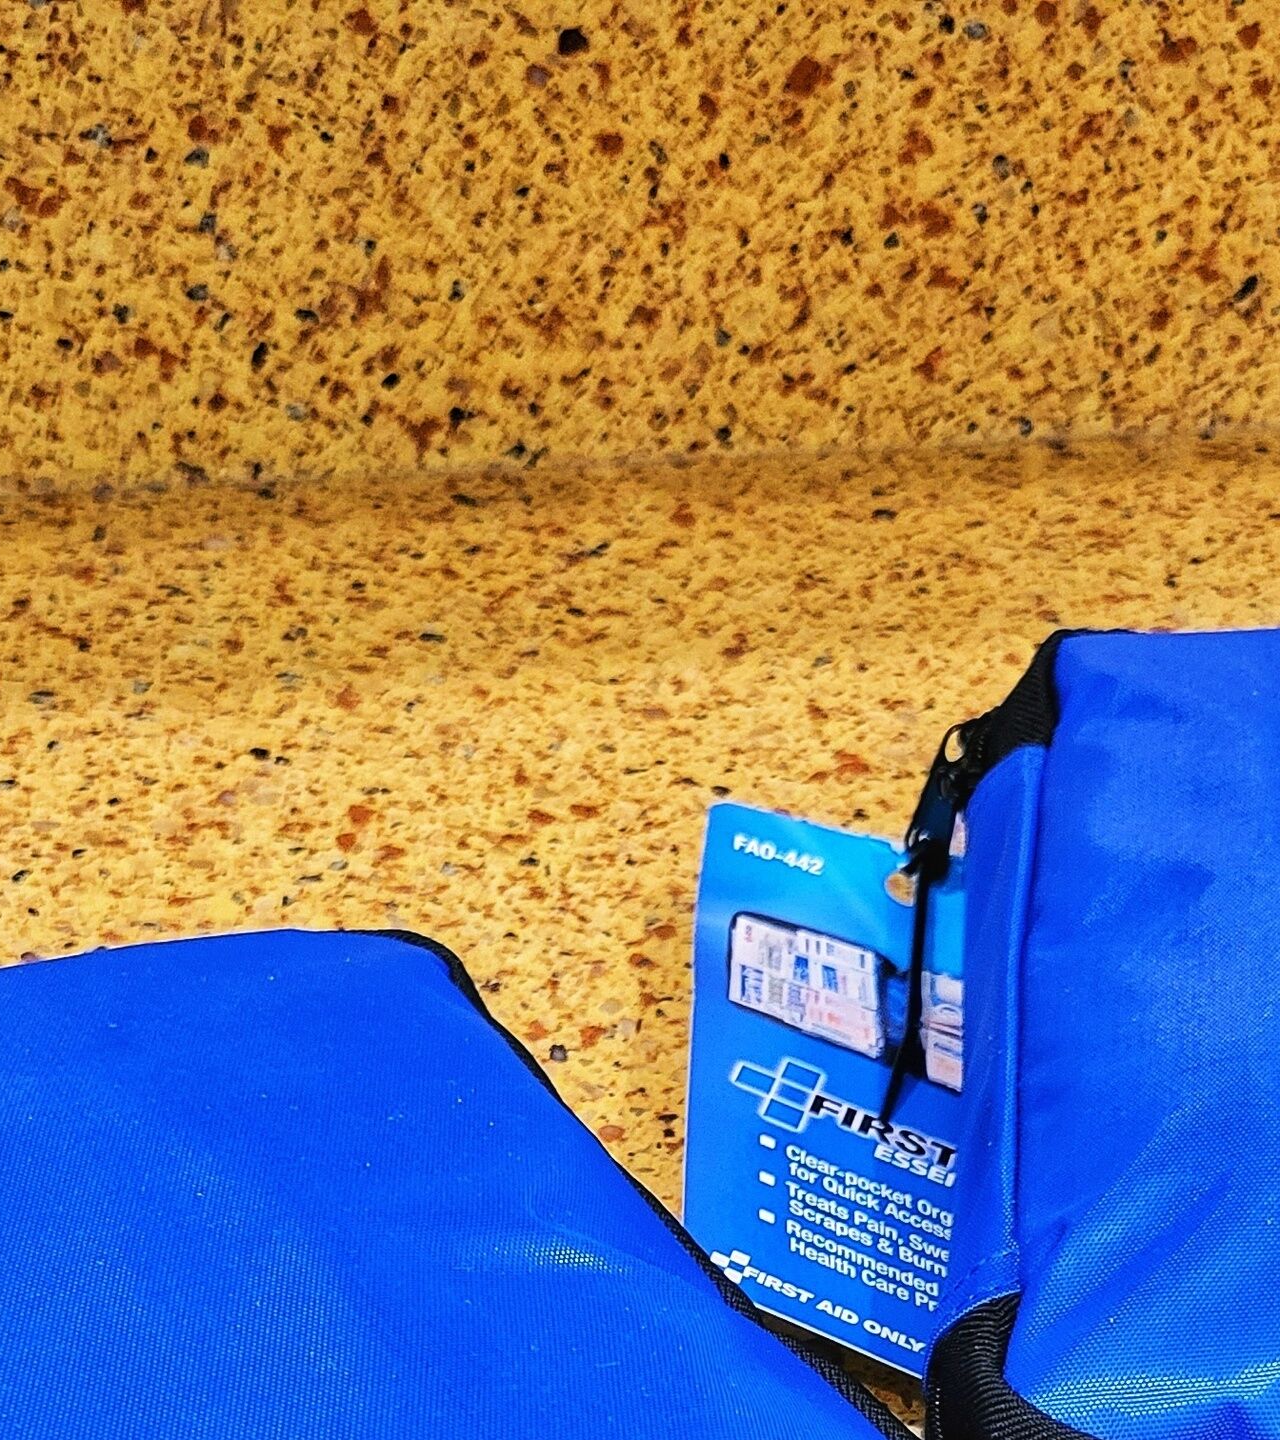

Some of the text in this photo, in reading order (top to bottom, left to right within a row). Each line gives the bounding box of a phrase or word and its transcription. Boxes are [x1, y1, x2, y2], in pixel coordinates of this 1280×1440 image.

[734, 833, 823, 875] FAO-442
[809, 1094, 956, 1168] FIRST
[787, 1146, 912, 1209] Clear-pocket
[790, 1163, 818, 1184] for
[823, 1177, 880, 1211] Quick
[786, 1181, 849, 1220] Treats
[854, 1211, 904, 1246] Pain,
[790, 1200, 872, 1247] Scrapes
[877, 1238, 894, 1256] &
[787, 1220, 939, 1297] Recommended
[791, 1238, 857, 1279] Health
[862, 1270, 909, 1301] Care
[743, 1266, 815, 1304] FIRST
[816, 1300, 859, 1325] AID
